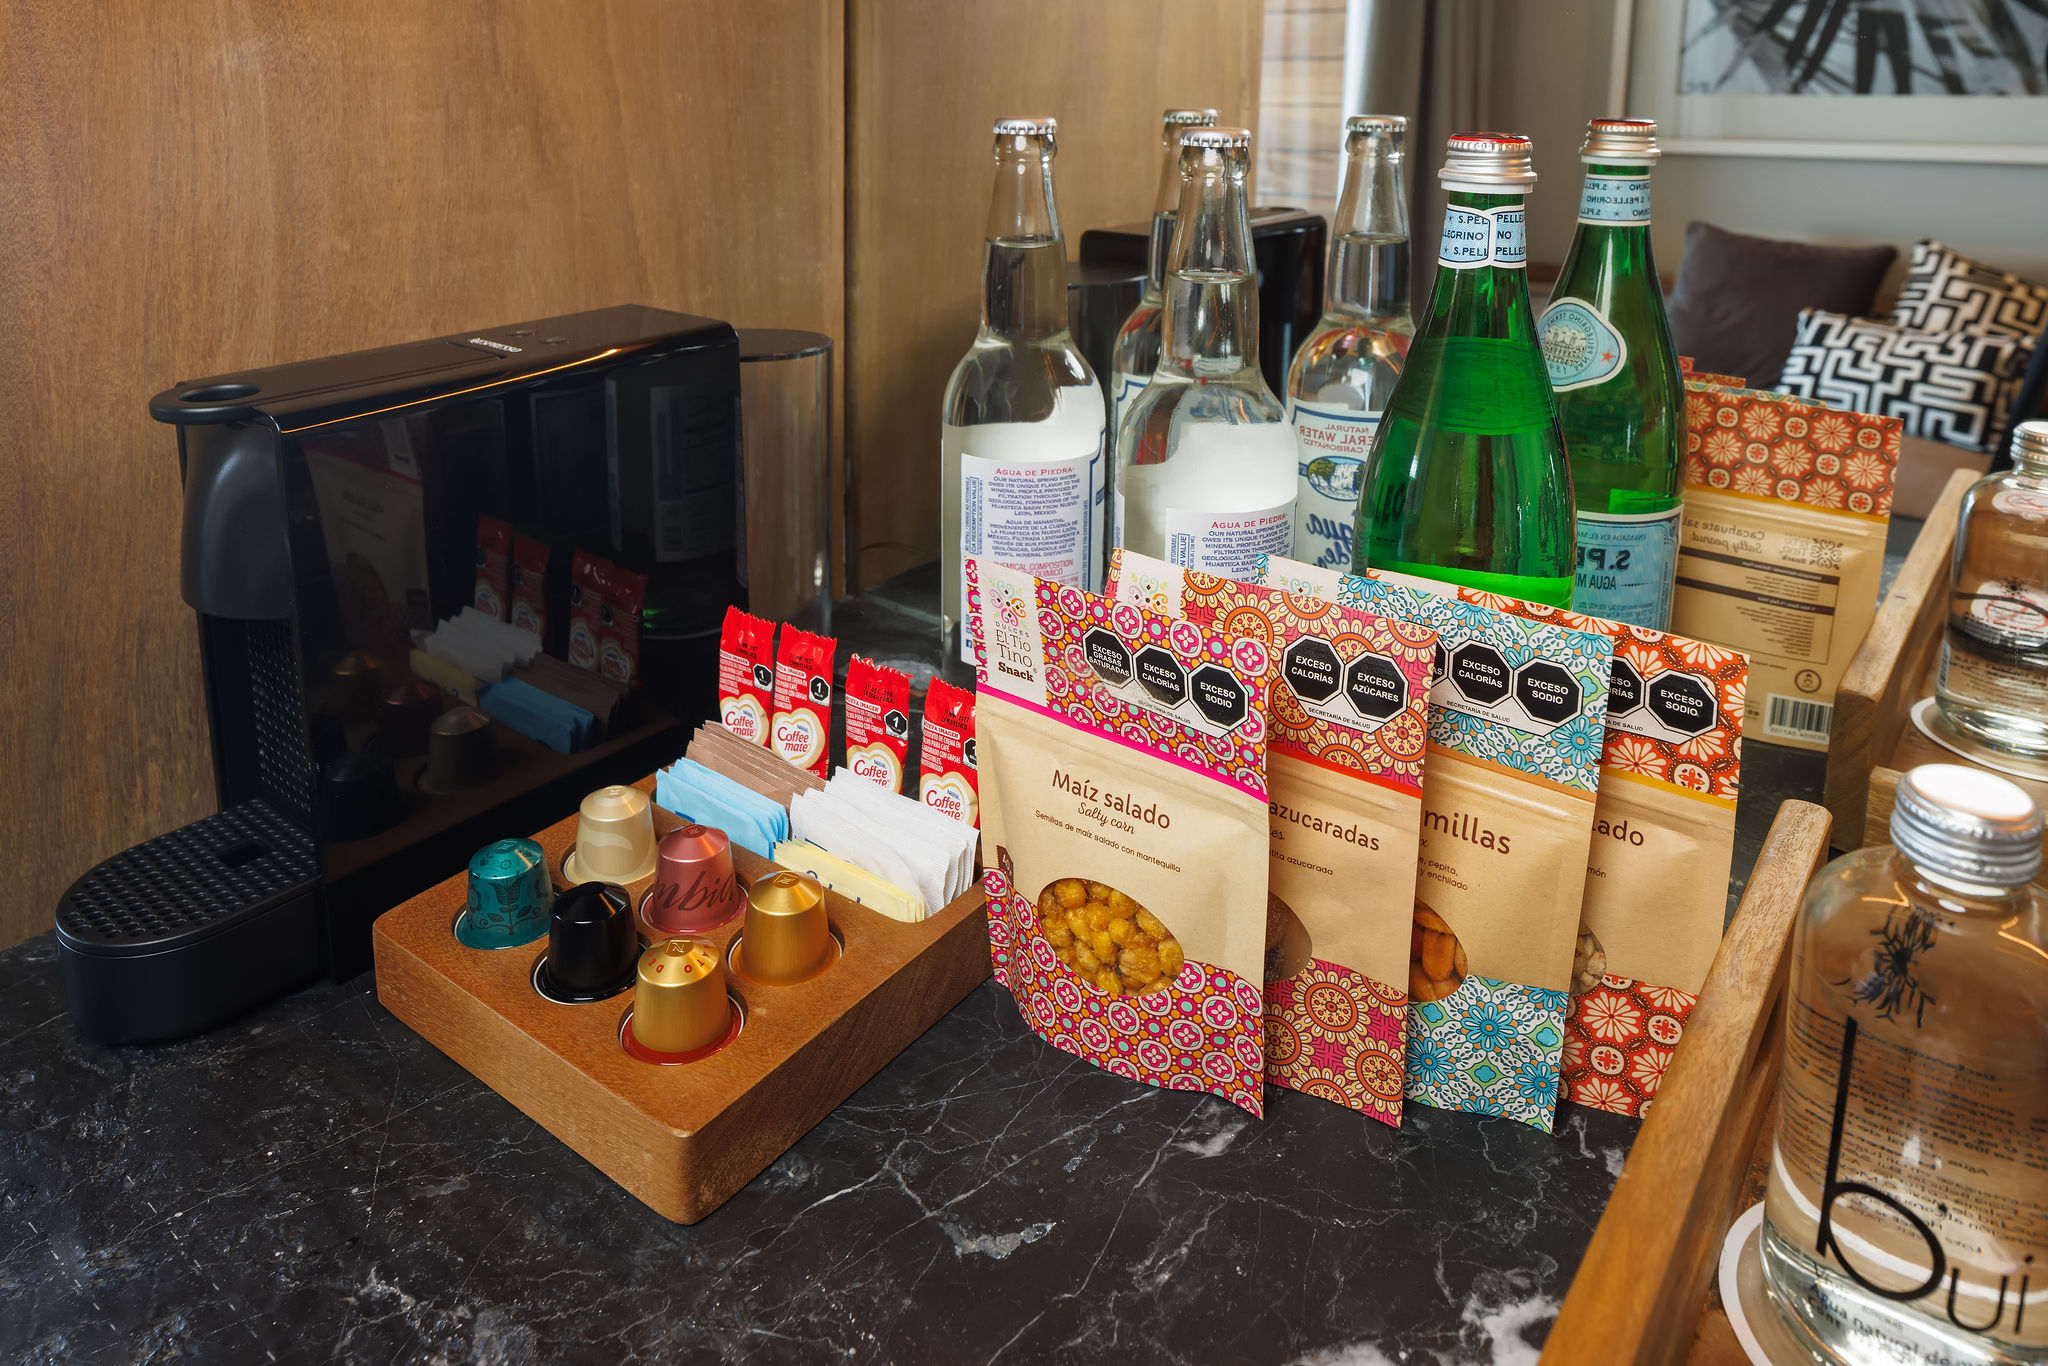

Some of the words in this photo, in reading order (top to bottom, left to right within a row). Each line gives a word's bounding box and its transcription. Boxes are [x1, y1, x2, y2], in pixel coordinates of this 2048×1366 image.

[1497, 231, 1511, 239] NO
[996, 468, 1022, 476] AGUA
[1259, 514, 1286, 525] PIEDRA
[1236, 540, 1260, 548] PROFILE
[1029, 558, 1073, 570] COMPOSITION
[995, 621, 1029, 638] DULCES
[996, 629, 1008, 645] El
[1010, 635, 1031, 652] Tío
[997, 643, 1033, 667] Tino
[1092, 643, 1122, 660] EXCESO
[1093, 651, 1122, 667] GRASAS
[999, 661, 1034, 683] Snack
[1088, 656, 1130, 677] SATURADAS
[1144, 663, 1177, 680] EXCESO
[1295, 655, 1332, 672] EXCESO
[1462, 659, 1501, 676] EXCESO
[759, 670, 764, 679] 1
[1142, 673, 1180, 692] CALORÍAS
[1291, 667, 1334, 685] CALORÍAS
[1357, 672, 1395, 690] EXCESO
[1458, 669, 1503, 688] CALORÍAS
[816, 682, 821, 693] 1
[1200, 681, 1236, 699] EXCESO
[1352, 684, 1399, 703] AZÚCARES
[1527, 677, 1569, 695] EXCESO
[1205, 693, 1233, 708] SODIO
[1532, 690, 1563, 705] SODIO
[1660, 689, 1703, 708] EXCESO
[1447, 700, 1482, 716] SECRETARÍA
[1491, 713, 1511, 723] SALUD
[1665, 701, 1698, 716] SODIO
[725, 711, 754, 728] Coffee
[893, 716, 899, 727] 1
[1308, 707, 1341, 721] SECRETARÍA
[1351, 720, 1371, 729] SALUD
[1622, 722, 1643, 731] SALUD
[777, 727, 809, 743] Coffee
[785, 742, 809, 753] mate
[854, 759, 888, 778] Coffee
[926, 790, 961, 811] Coffee
[1052, 770, 1098, 802] Maíz
[1104, 794, 1170, 829] salado
[1078, 802, 1109, 826] Salty
[1110, 818, 1136, 834] corn
[1269, 801, 1380, 851] azucaradas
[1035, 810, 1063, 827] Semillas
[1065, 822, 1074, 832] de
[1076, 828, 1092, 839] maíz
[1094, 834, 1119, 849] salado
[1121, 845, 1134, 856] con
[1136, 851, 1181, 872] mantequilla
[1423, 809, 1512, 855] millas
[1287, 856, 1333, 876] azucarada
[1428, 858, 1458, 877] pepita,
[1419, 868, 1426, 877] y
[1427, 870, 1468, 891] enchilado
